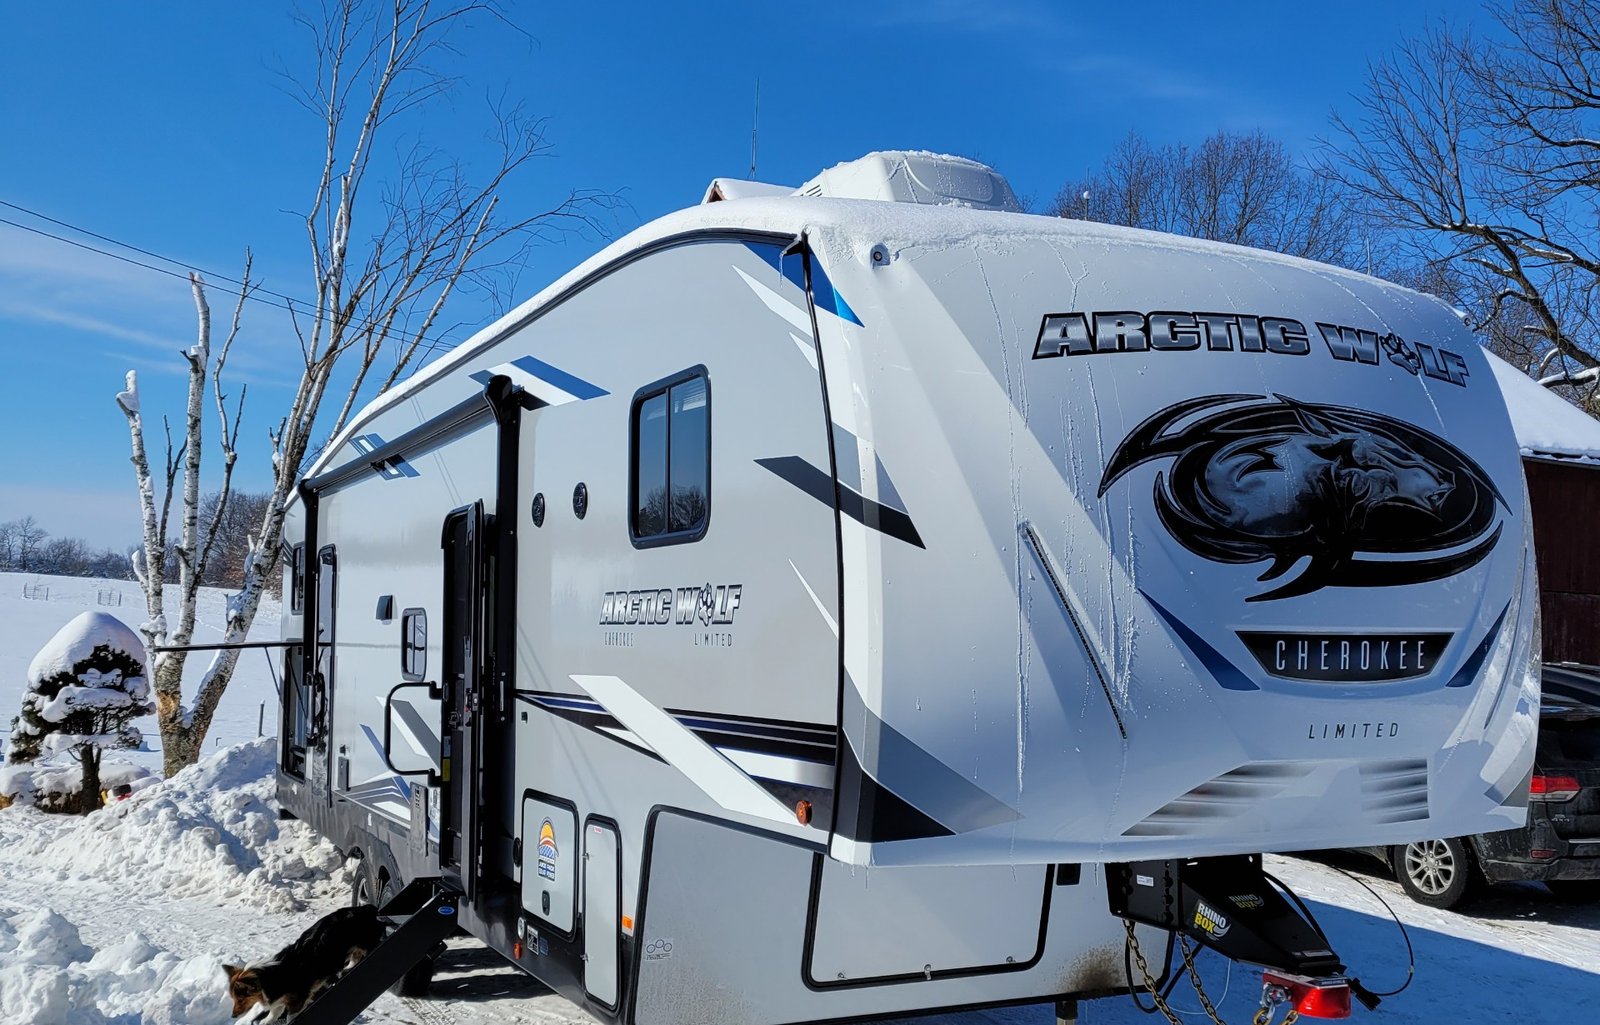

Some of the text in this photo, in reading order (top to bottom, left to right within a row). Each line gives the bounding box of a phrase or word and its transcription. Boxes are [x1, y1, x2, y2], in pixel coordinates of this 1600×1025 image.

[1032, 311, 1311, 359] ARCTIC
[599, 588, 673, 625] ARCTIC
[694, 633, 732, 647] LIMITED
[1275, 640, 1425, 671] CHEROKEE
[1308, 722, 1399, 740] LIMITED
[1194, 912, 1216, 934] BOX
[1197, 902, 1226, 928] RHINO
